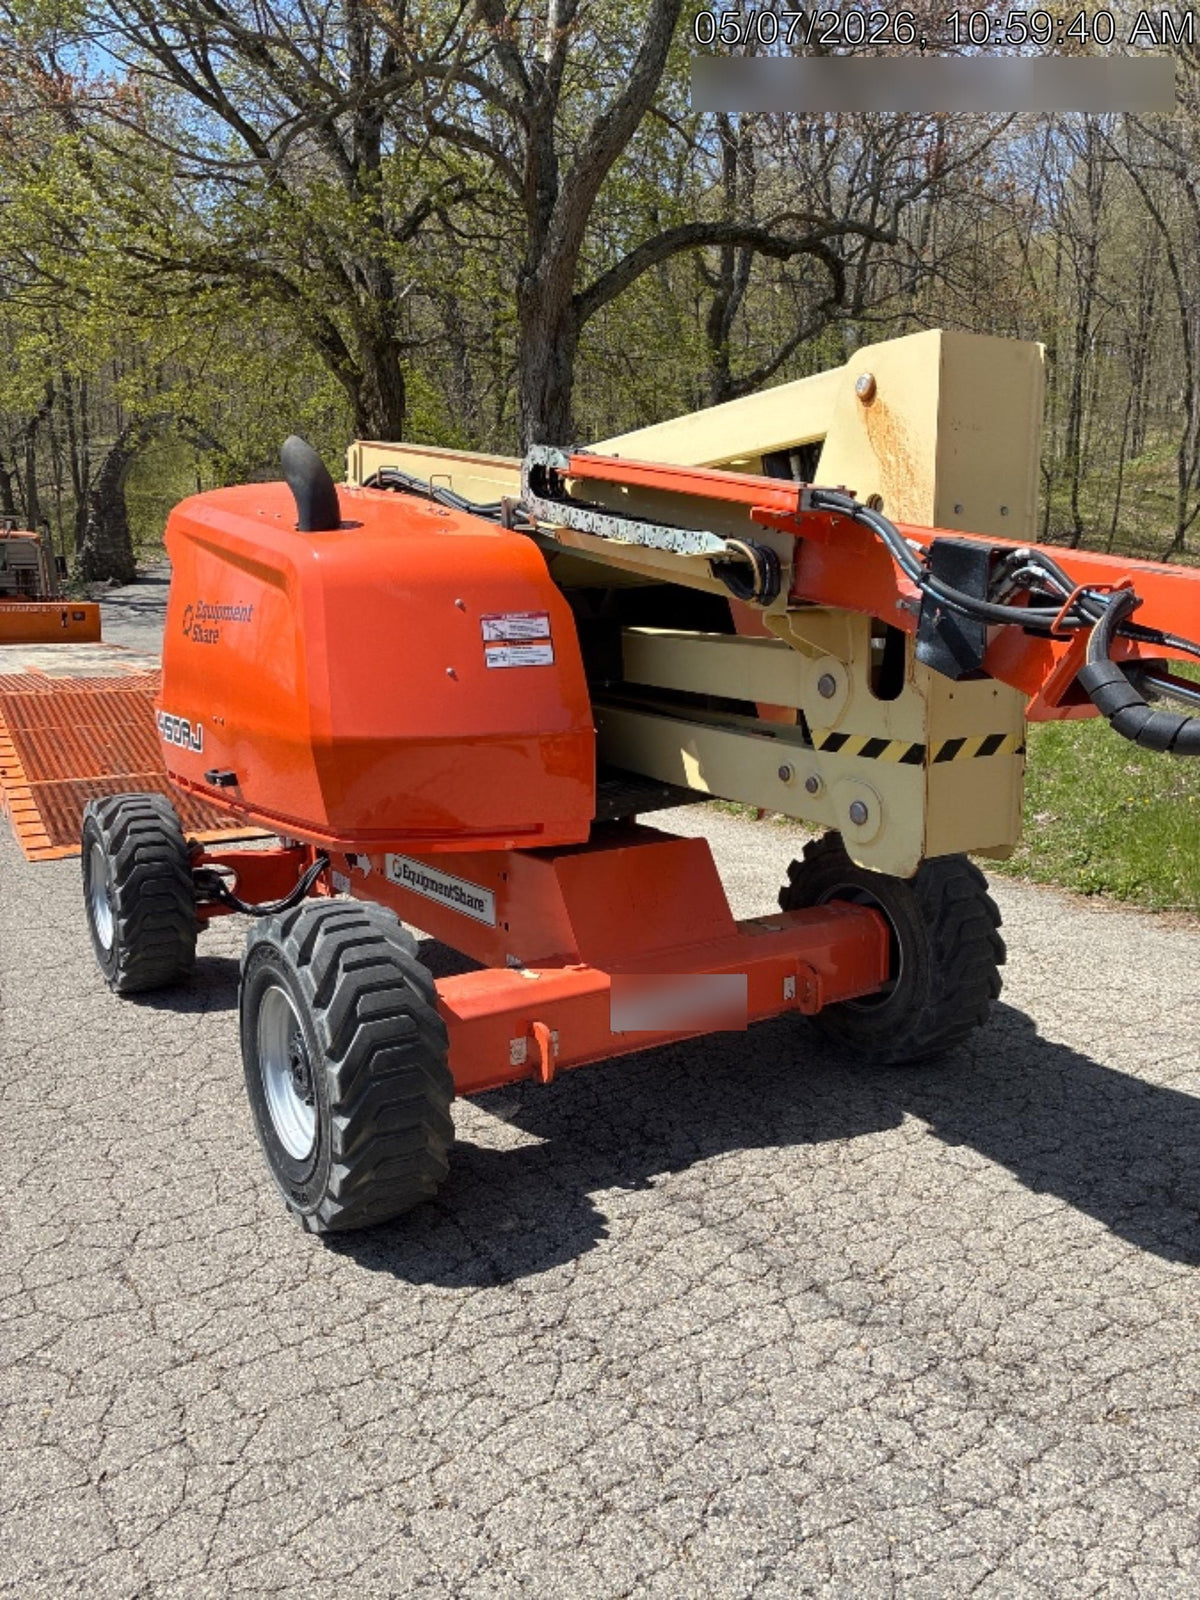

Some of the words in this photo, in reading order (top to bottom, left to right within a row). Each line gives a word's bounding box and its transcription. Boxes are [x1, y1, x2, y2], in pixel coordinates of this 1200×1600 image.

[195, 600, 253, 624] Equipment
[192, 623, 219, 645] Share
[402, 863, 485, 913] EquipmentShare
